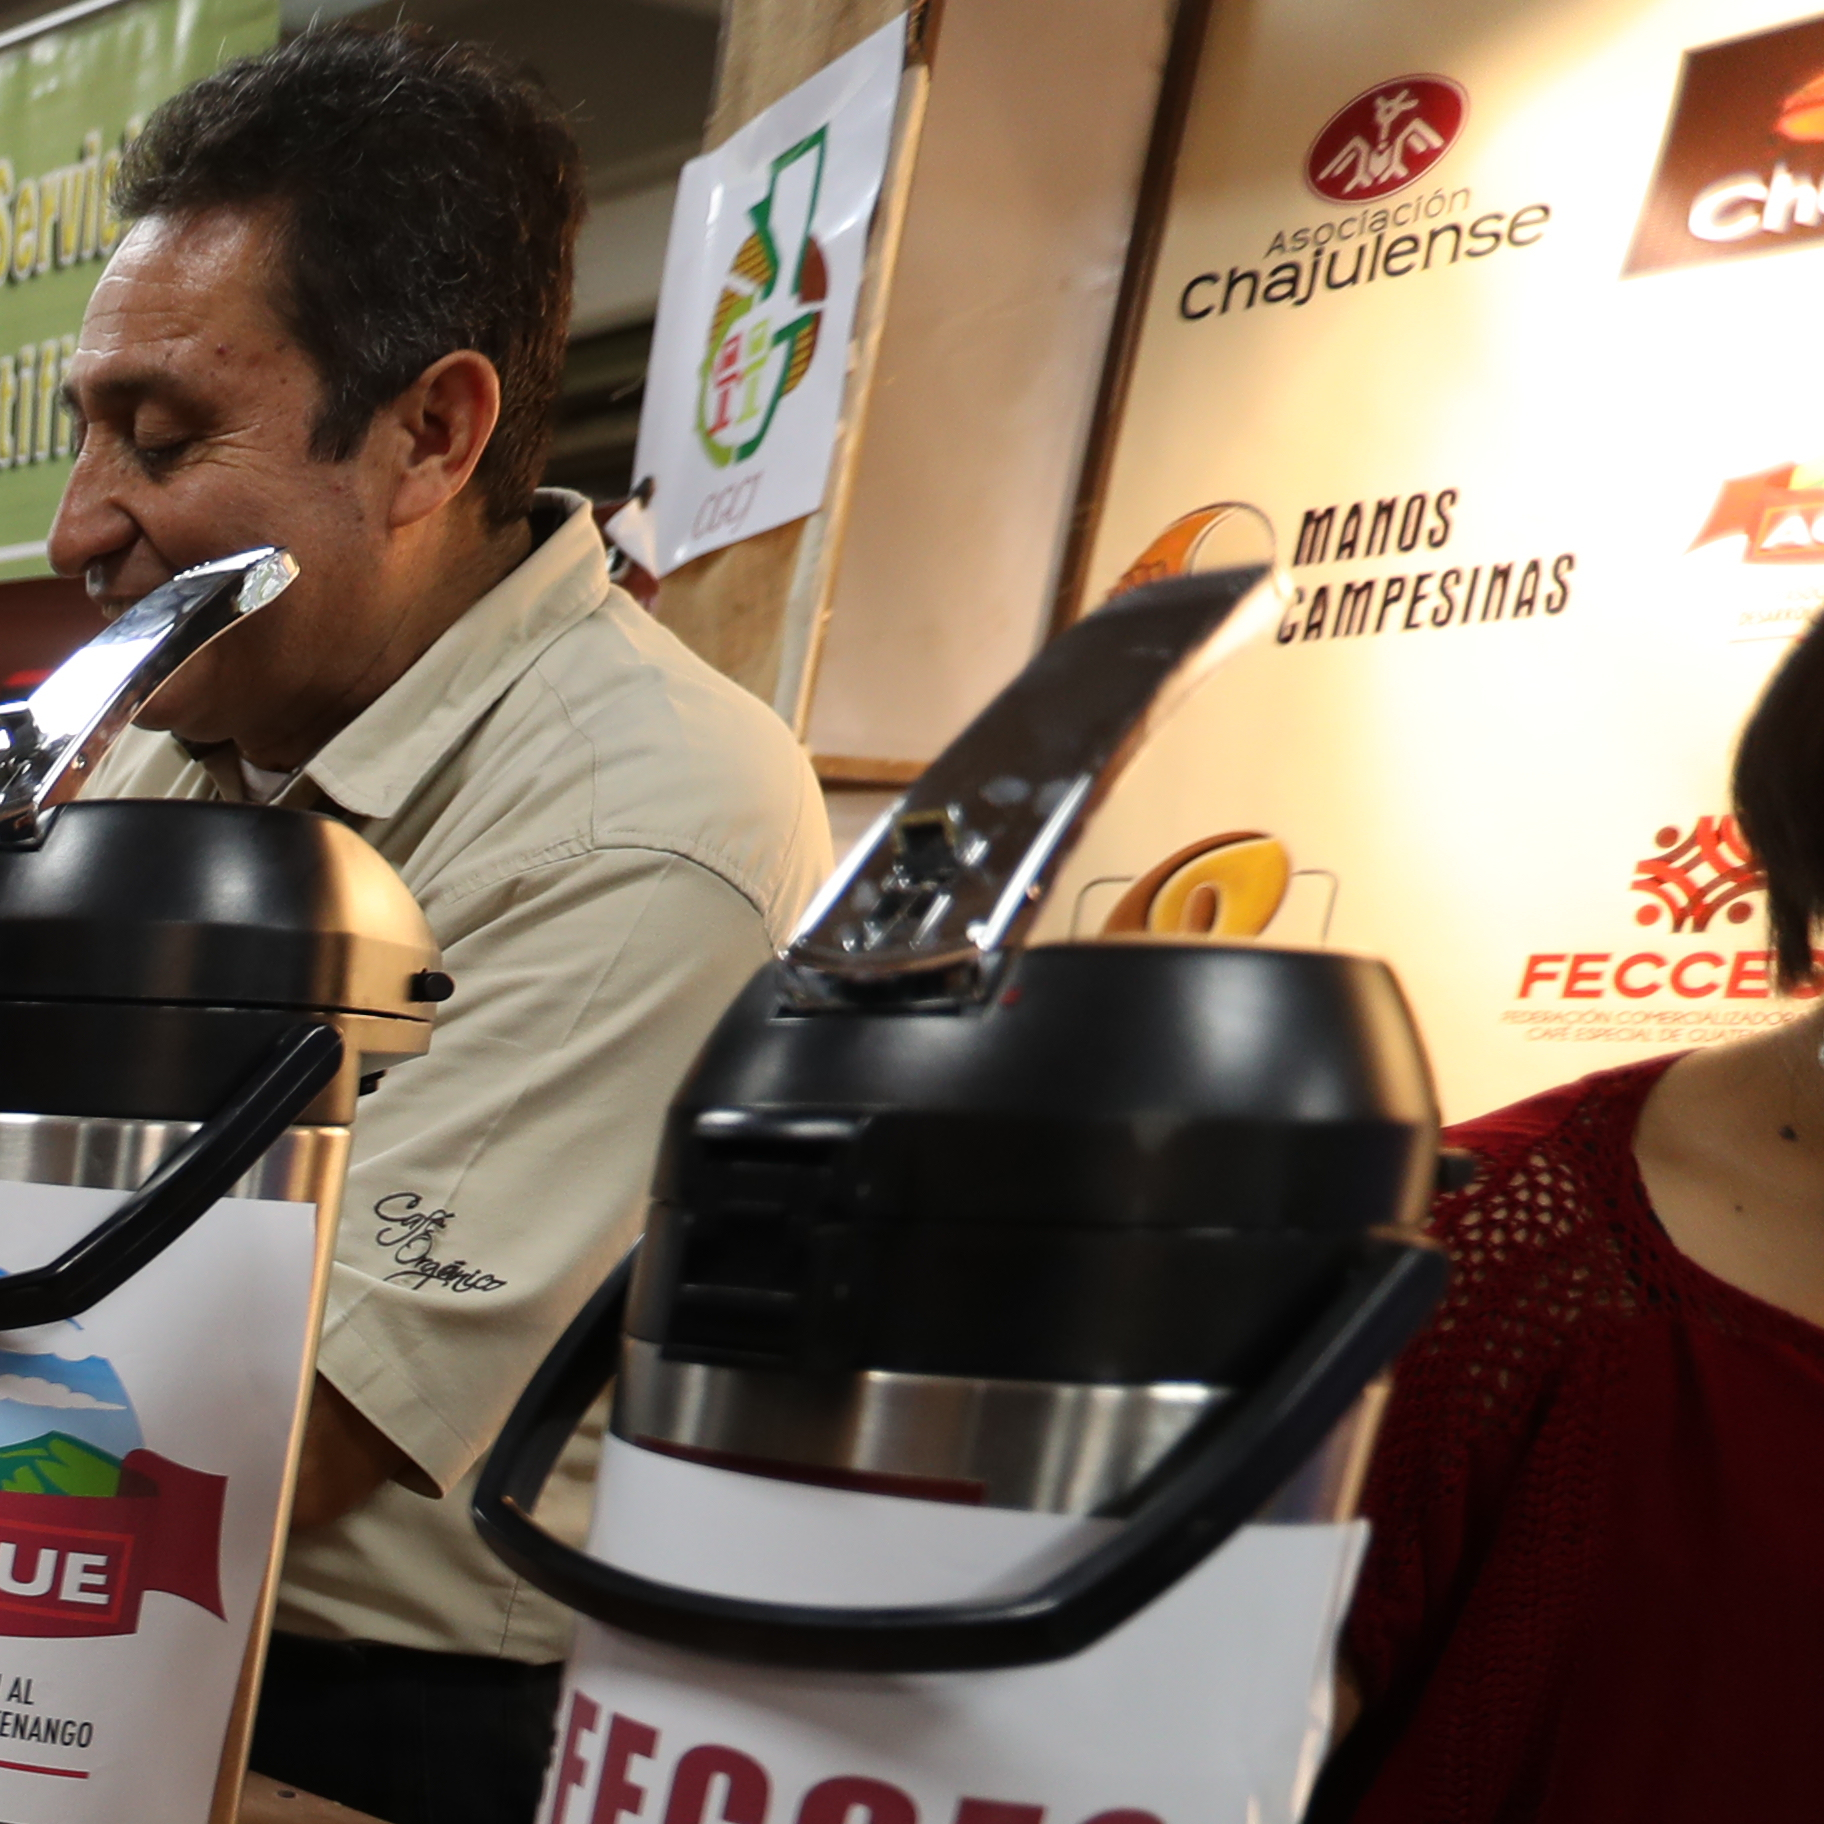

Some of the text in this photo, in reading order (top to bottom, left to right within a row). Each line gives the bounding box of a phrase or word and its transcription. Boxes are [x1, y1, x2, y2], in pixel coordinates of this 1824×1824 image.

[1264, 186, 1471, 260] Asociación
[1292, 487, 1462, 569] MANOS
[1276, 553, 1577, 647] CAMPESINAS
[373, 1191, 455, 1247] Café
[6, 1676, 35, 1705] AL
